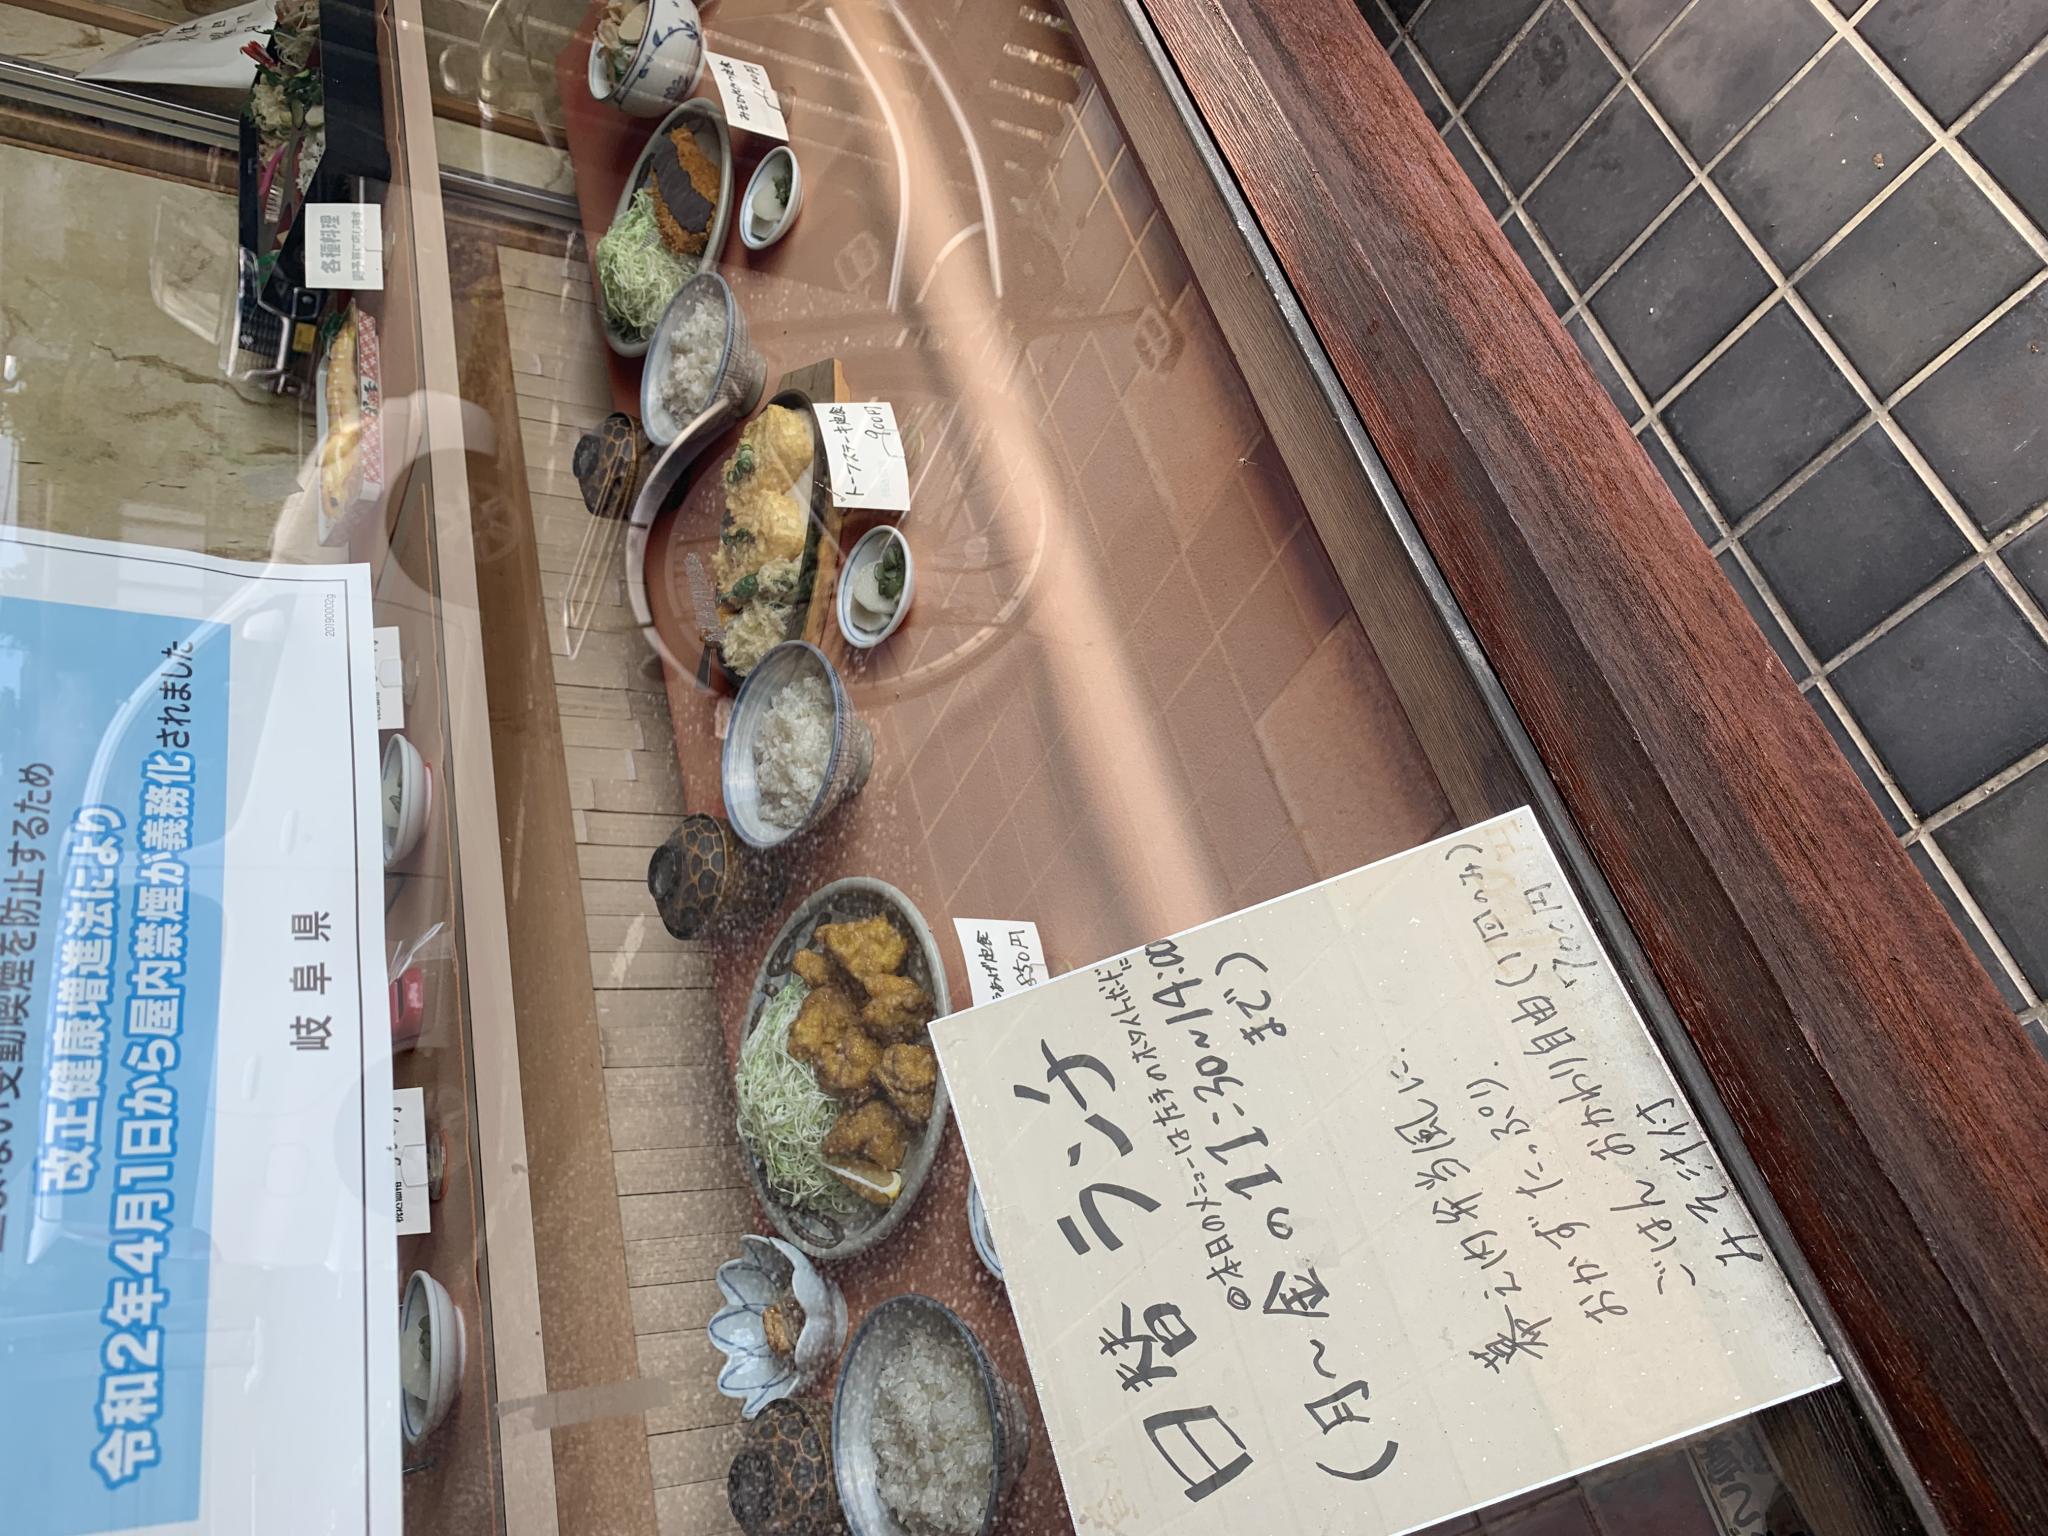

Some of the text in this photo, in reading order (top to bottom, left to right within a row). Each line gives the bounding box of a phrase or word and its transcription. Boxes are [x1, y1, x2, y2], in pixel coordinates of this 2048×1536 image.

[319, 215, 341, 274] 各種料理
[829, 405, 865, 496] トーフステーキ定食
[864, 406, 891, 439] 900円
[39, 807, 118, 1191] 改正健康増進法により
[290, 910, 332, 1051] 岐阜県
[1008, 929, 1037, 986] 850円
[94, 641, 194, 1484] 令和2年4月1日から屋内禁煙が義務化されました
